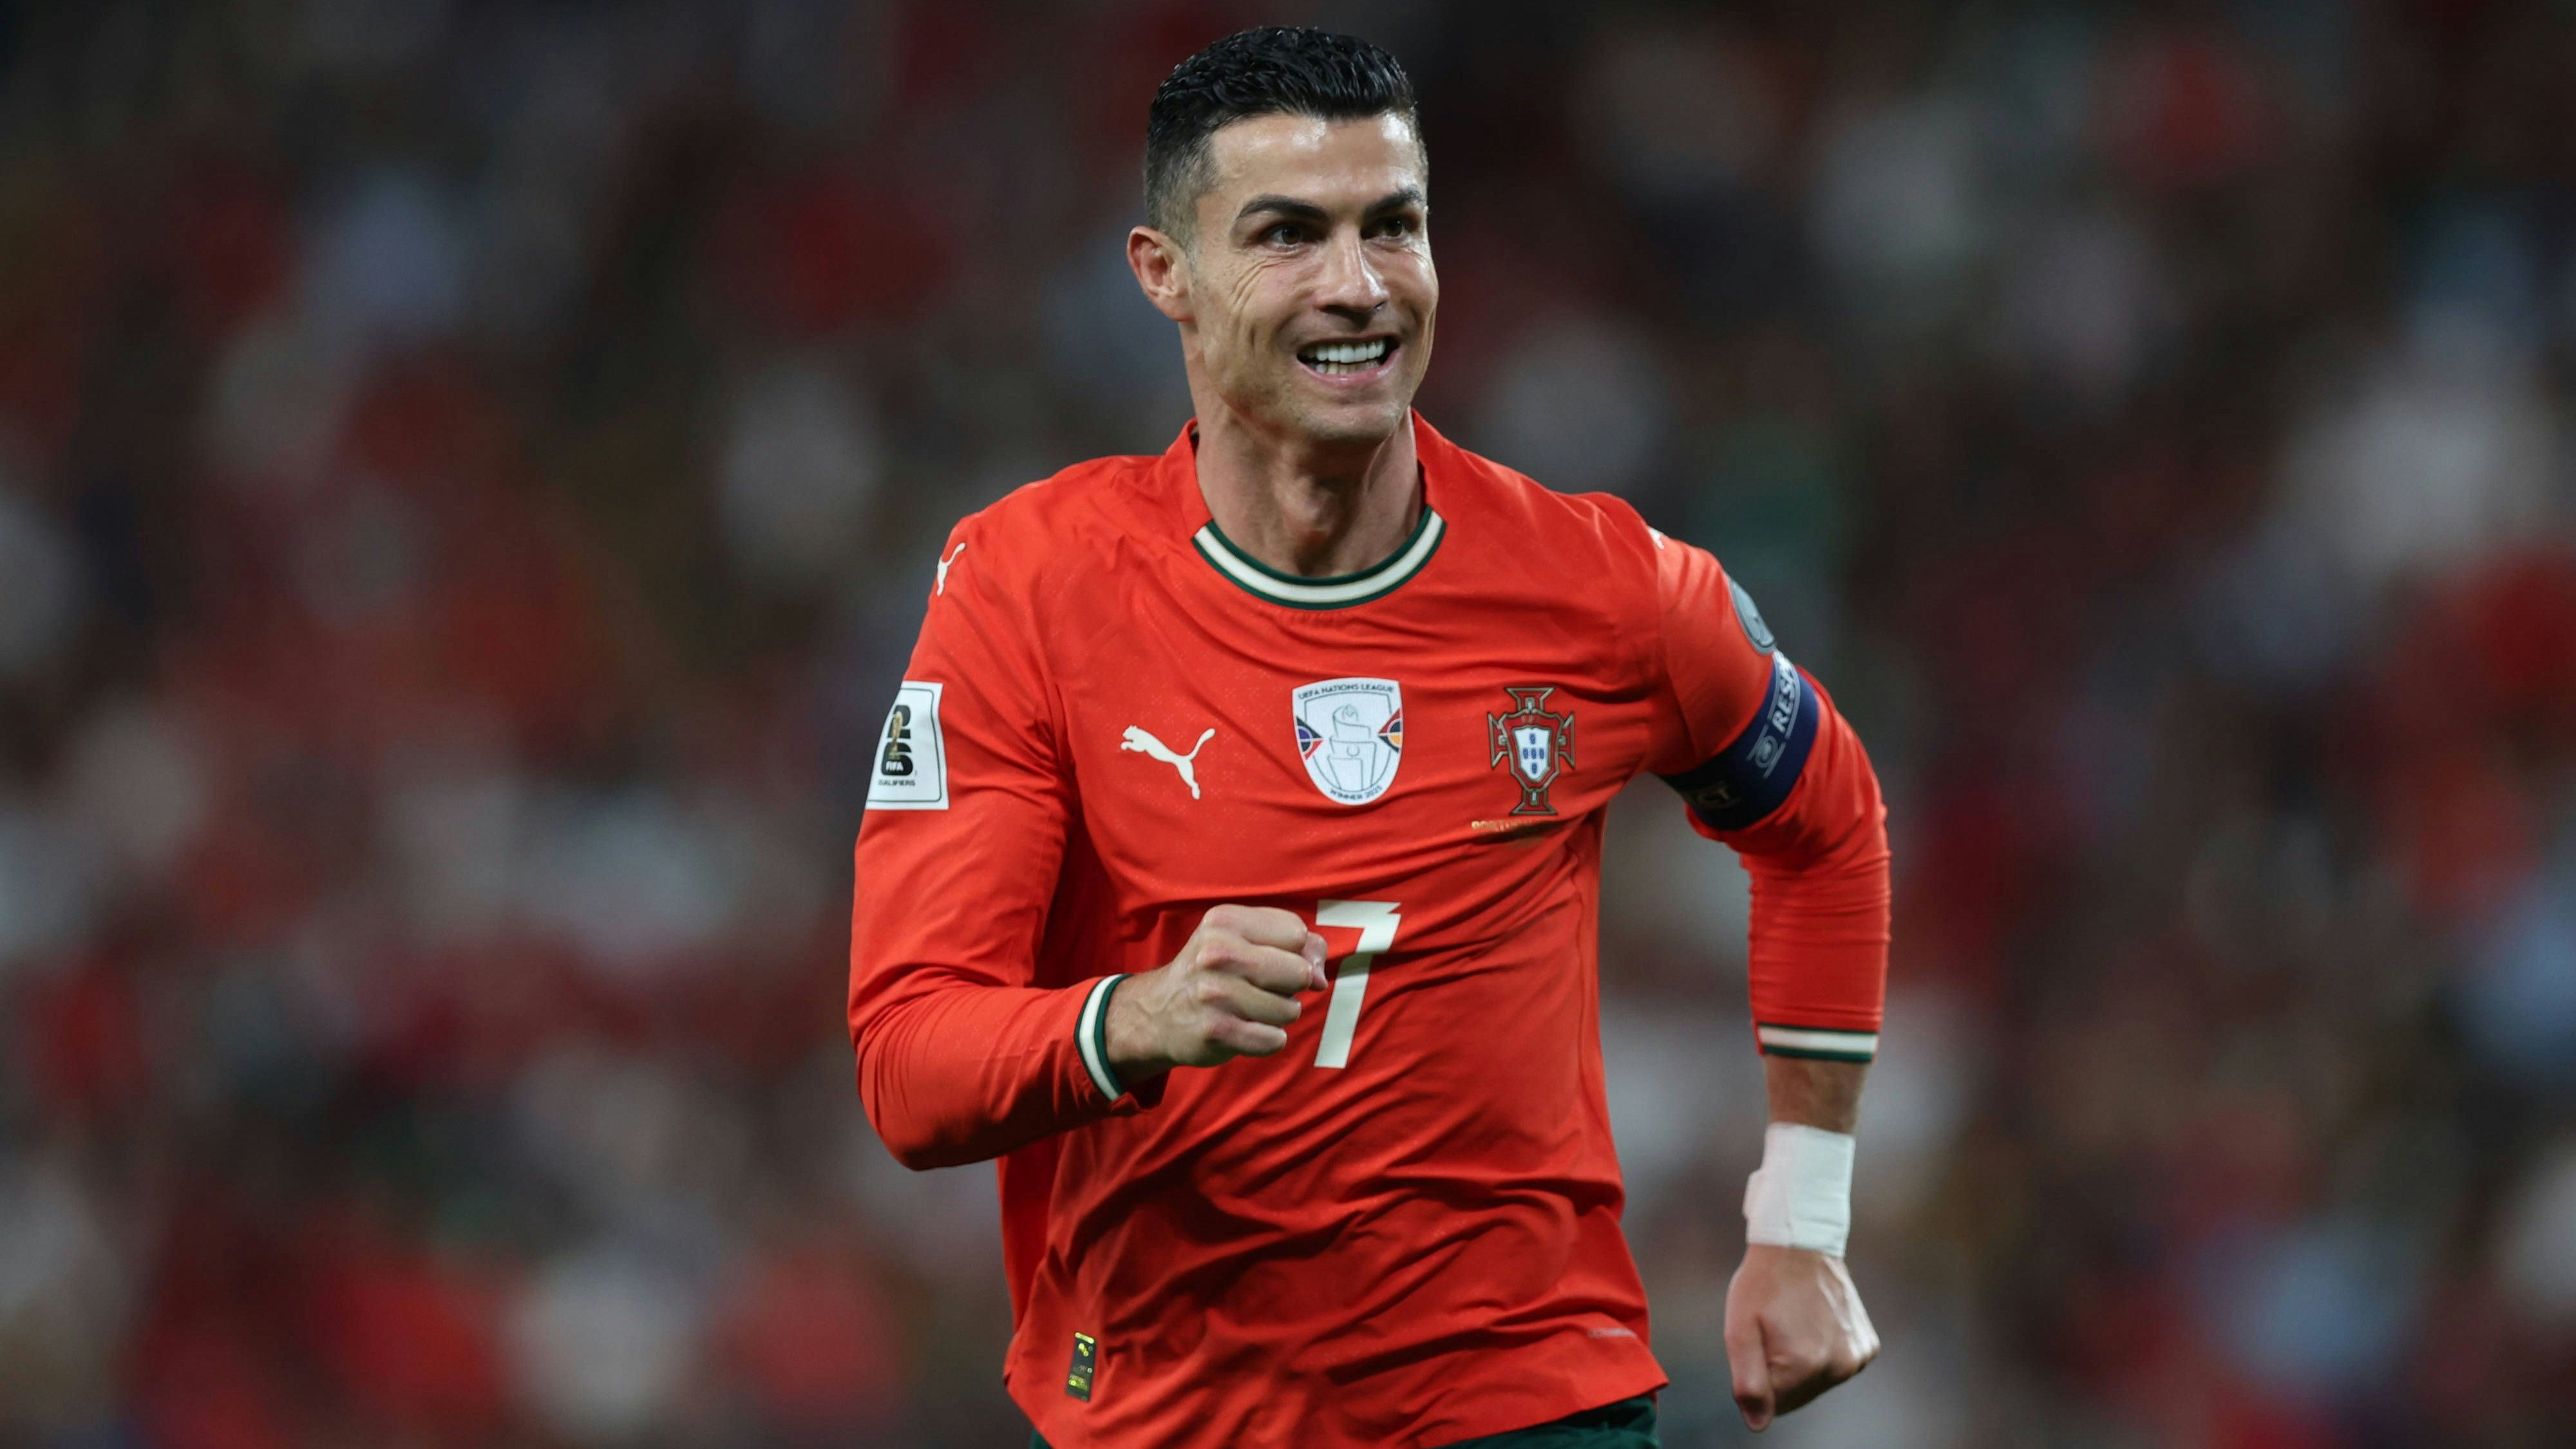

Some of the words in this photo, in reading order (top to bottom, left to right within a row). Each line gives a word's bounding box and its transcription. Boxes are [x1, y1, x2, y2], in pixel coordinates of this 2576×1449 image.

[1298, 690, 1320, 699] UEFA
[1321, 683, 1359, 693] NATIONS
[1361, 683, 1394, 693] LEAGUE
[886, 761, 904, 772] FIFA
[1331, 788, 1363, 799] WINNER
[1314, 899, 1401, 1069] 7
